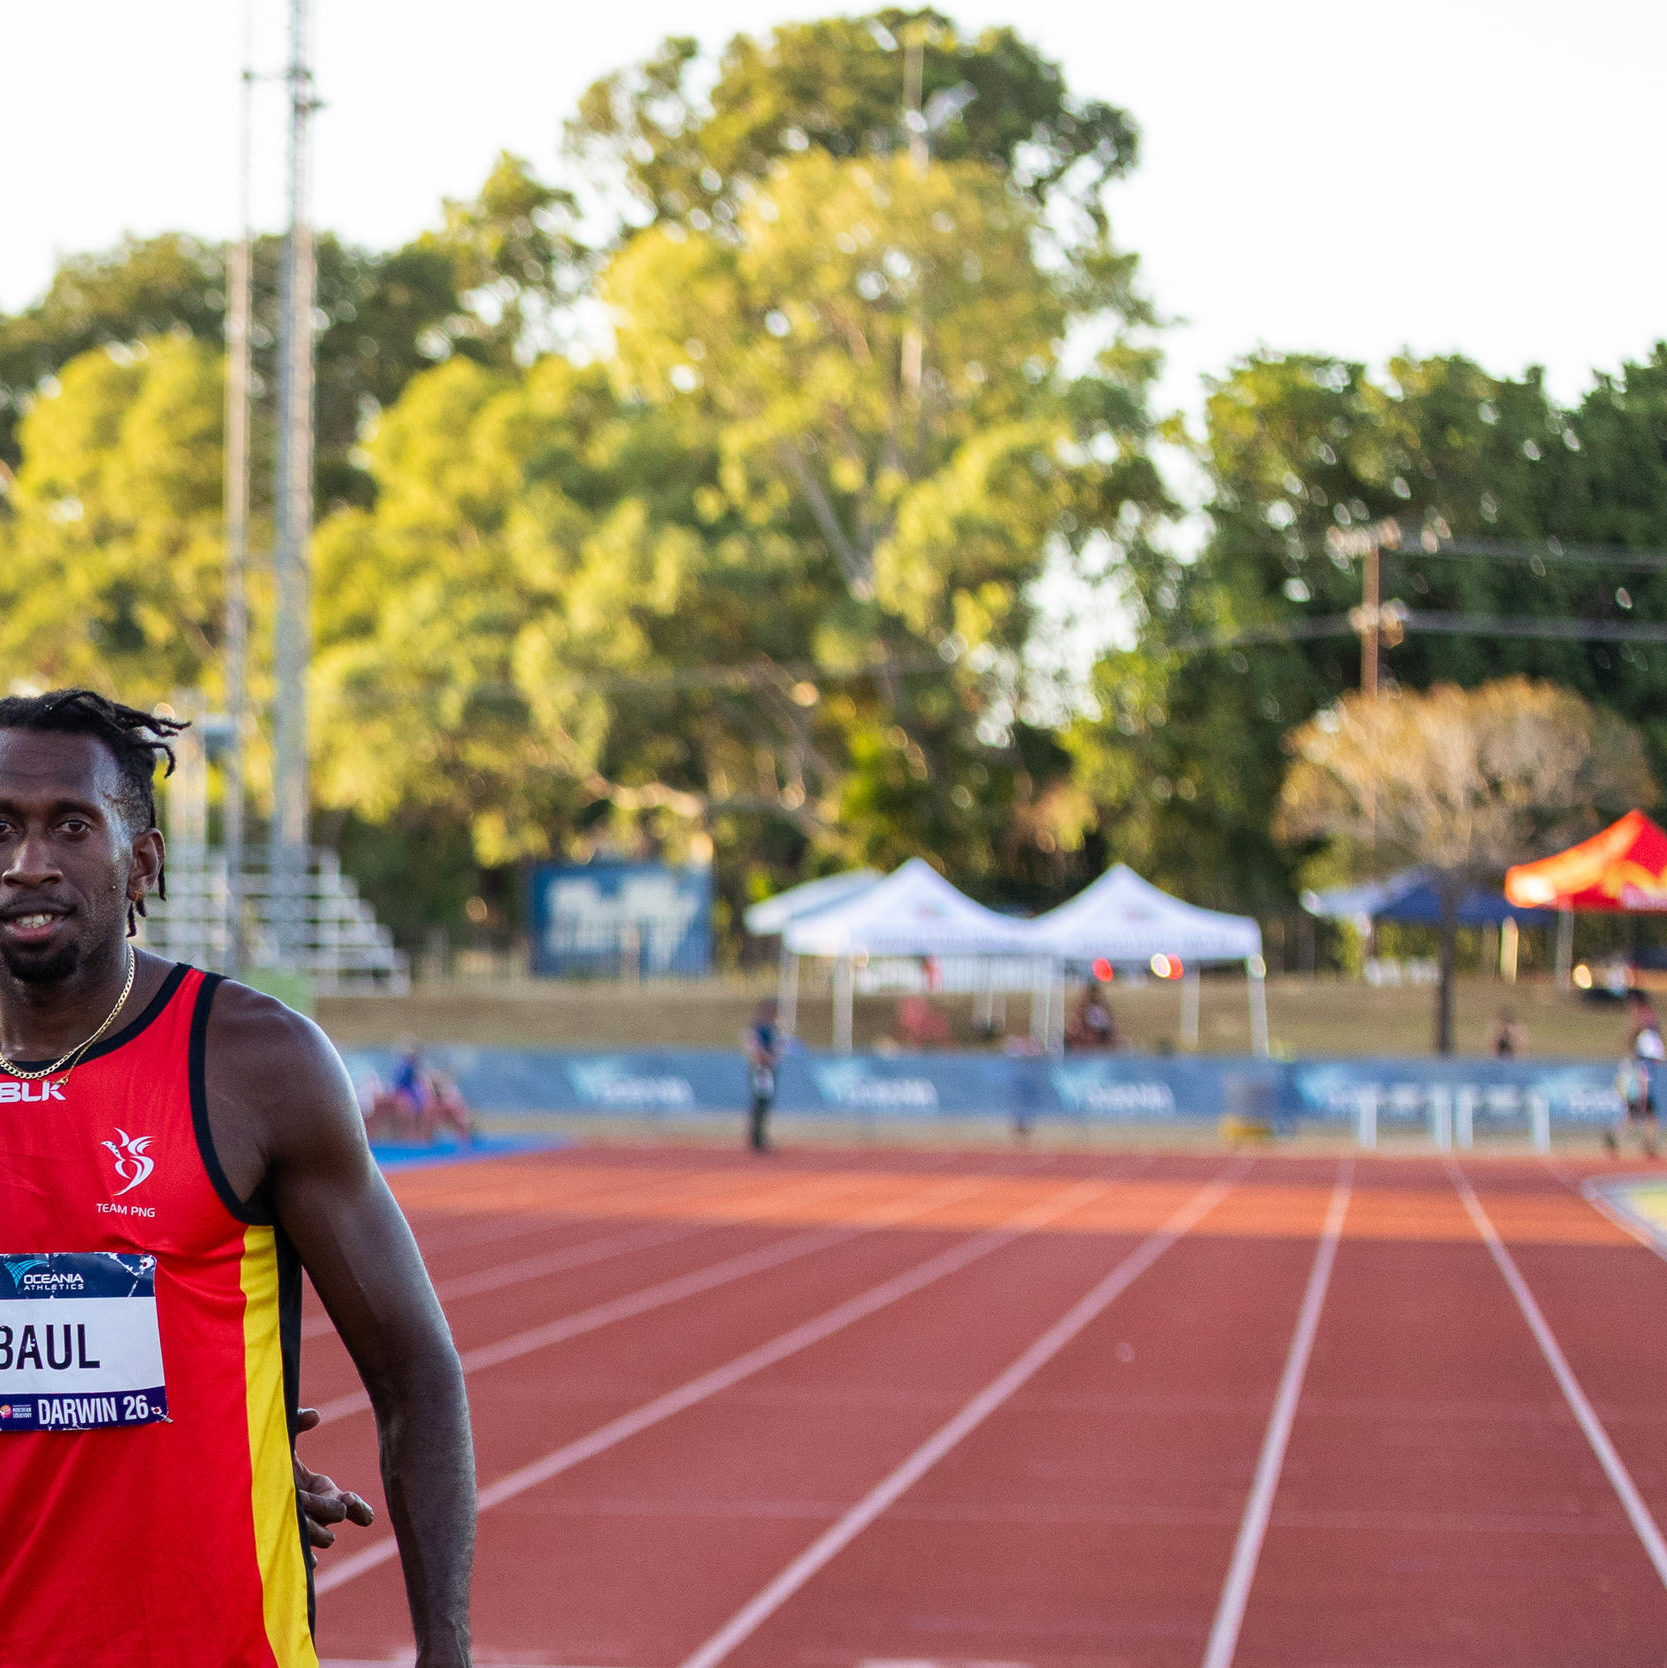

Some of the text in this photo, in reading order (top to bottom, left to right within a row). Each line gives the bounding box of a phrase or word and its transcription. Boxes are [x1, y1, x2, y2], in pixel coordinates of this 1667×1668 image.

[96, 1203, 156, 1218] TEAM PNG
[24, 1273, 84, 1284] OCEANIA
[38, 1394, 149, 1425] DARWIN 26
